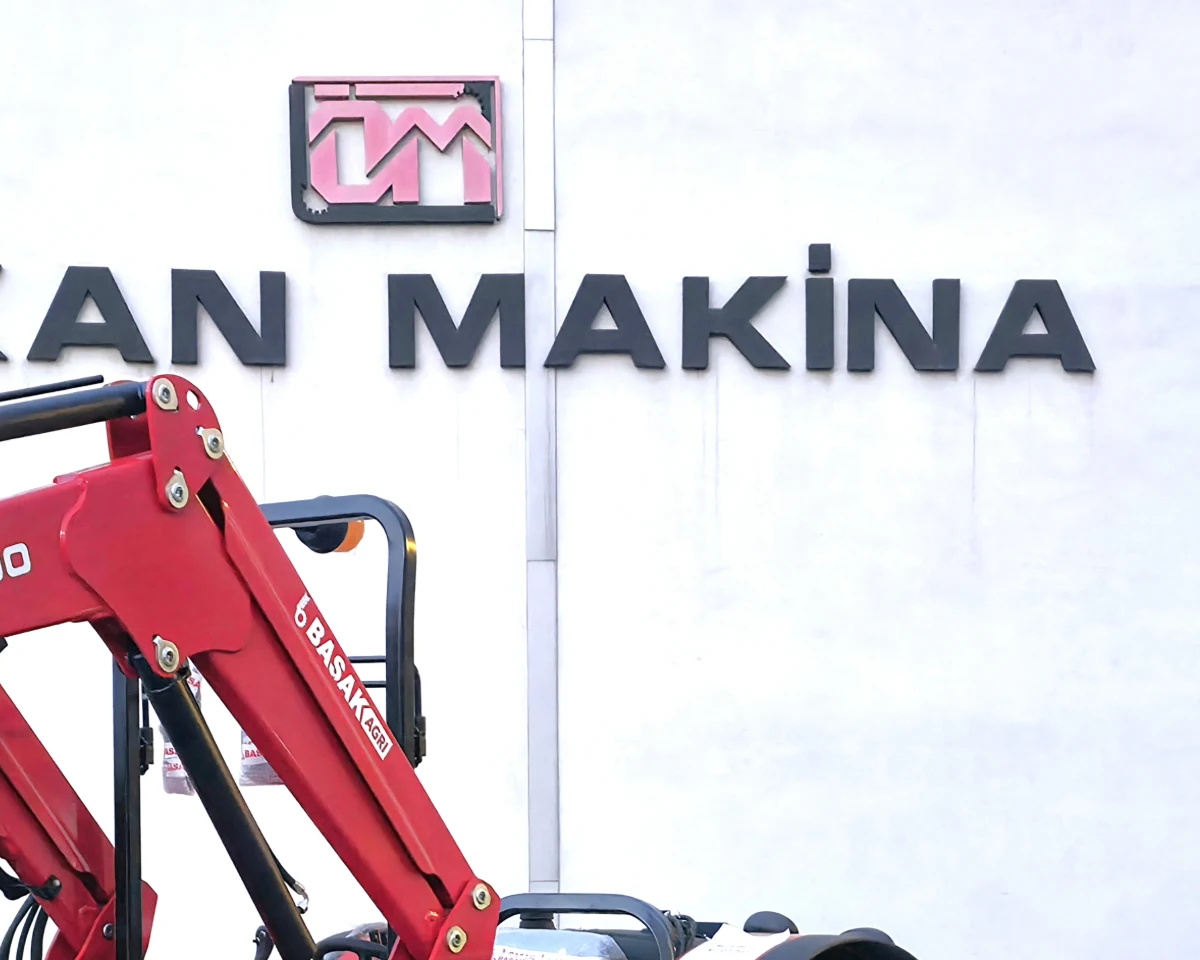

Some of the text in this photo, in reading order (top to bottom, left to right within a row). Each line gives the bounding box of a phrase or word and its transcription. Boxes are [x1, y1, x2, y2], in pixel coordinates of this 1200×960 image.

[387, 243, 1096, 373] MAKİNA
[305, 616, 370, 722] BASAK
[364, 717, 389, 753] AGRI
